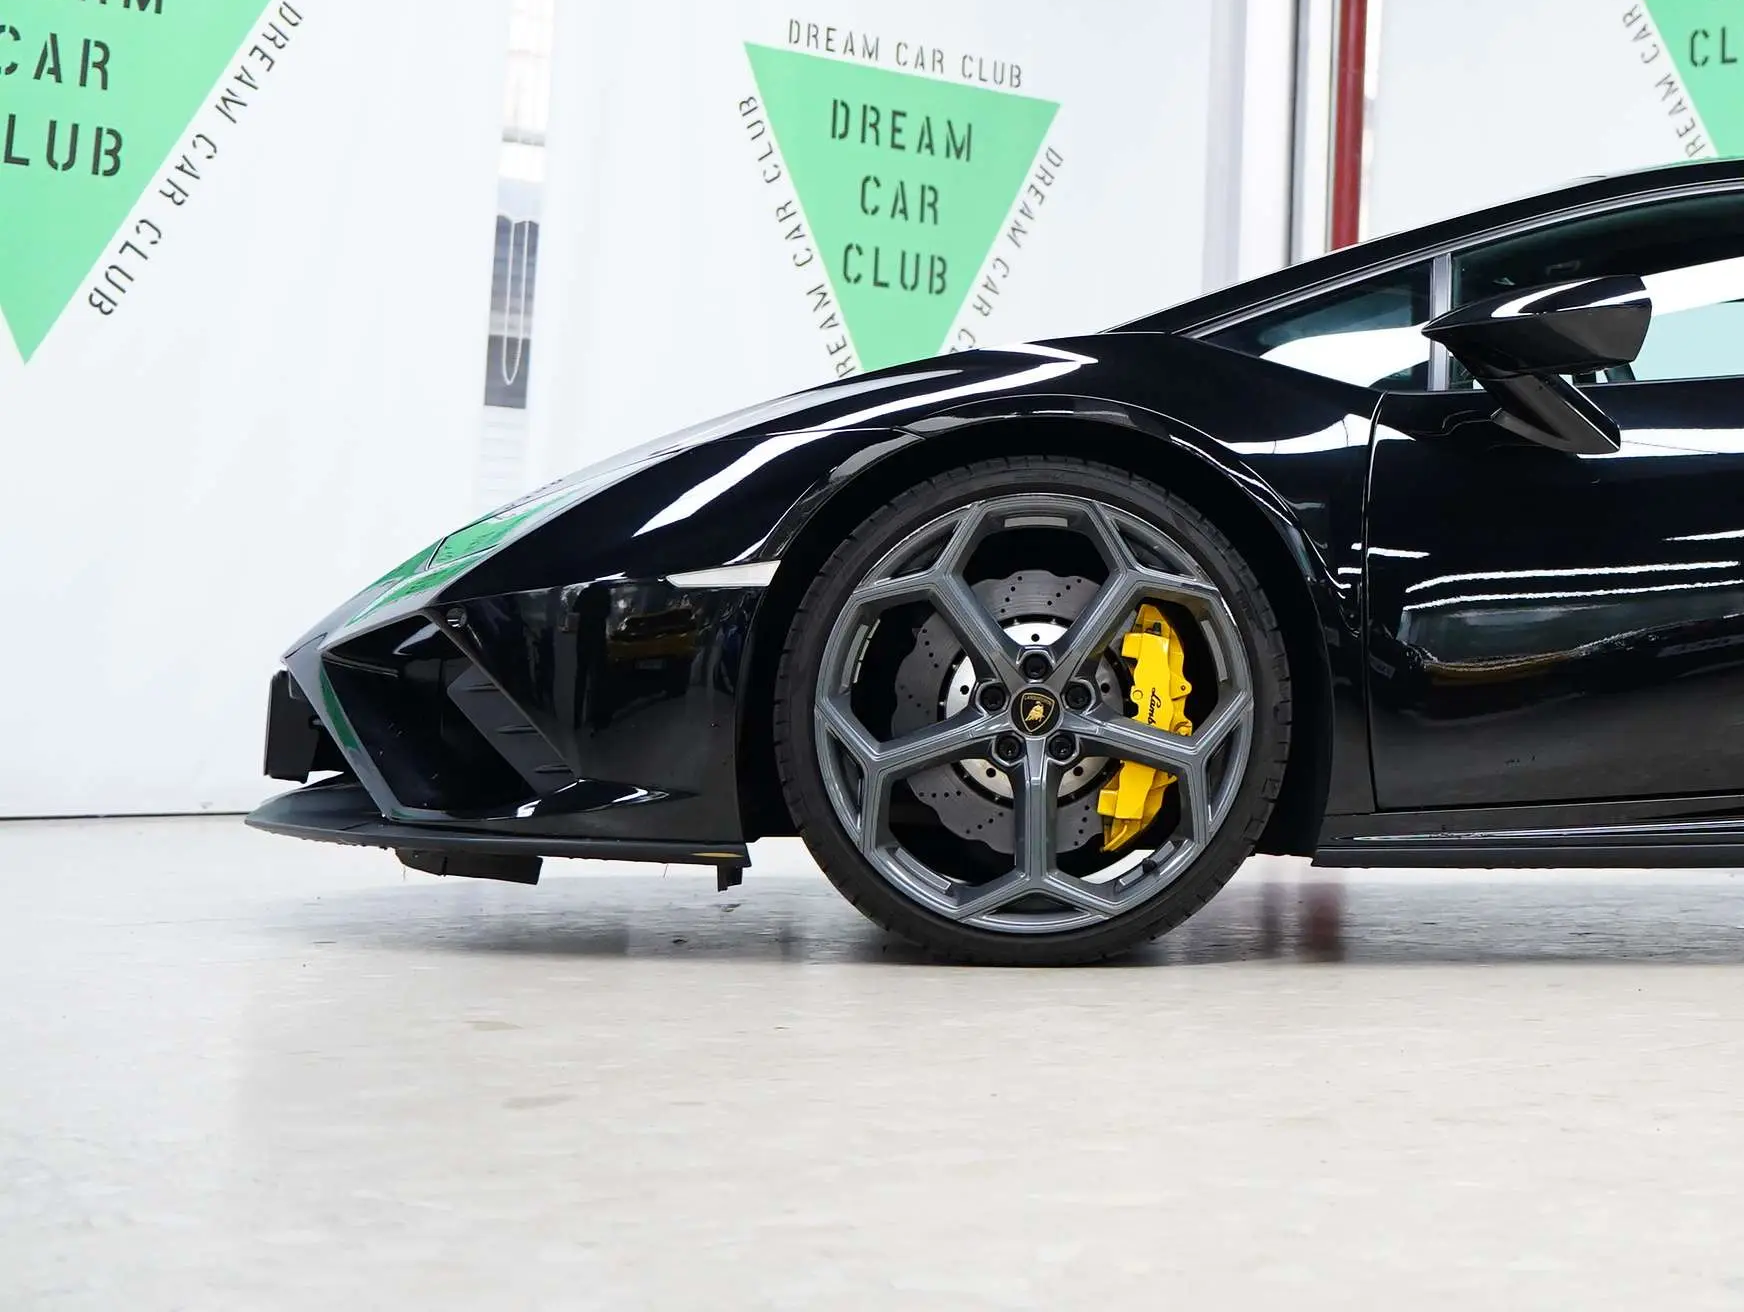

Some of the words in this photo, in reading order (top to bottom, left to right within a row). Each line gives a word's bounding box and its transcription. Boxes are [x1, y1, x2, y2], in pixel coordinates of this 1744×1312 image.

[214, 0, 303, 124] DREAM
[788, 18, 880, 62] DREAM
[895, 41, 944, 74] CAR
[961, 54, 1022, 89] CLUB
[1622, 3, 1660, 64] CAR
[3, 113, 123, 177] LUB
[738, 96, 782, 184] CLUB
[830, 98, 973, 163] DREAM
[1654, 72, 1706, 158] REAM
[158, 133, 218, 207] CAR
[860, 175, 939, 226] CAR
[1006, 146, 1064, 249] DREAM
[88, 218, 162, 316] CLUB
[775, 200, 814, 268] CAR
[842, 242, 948, 296] CLUB
[972, 257, 1010, 317] CAR
[806, 283, 856, 379] REAM
